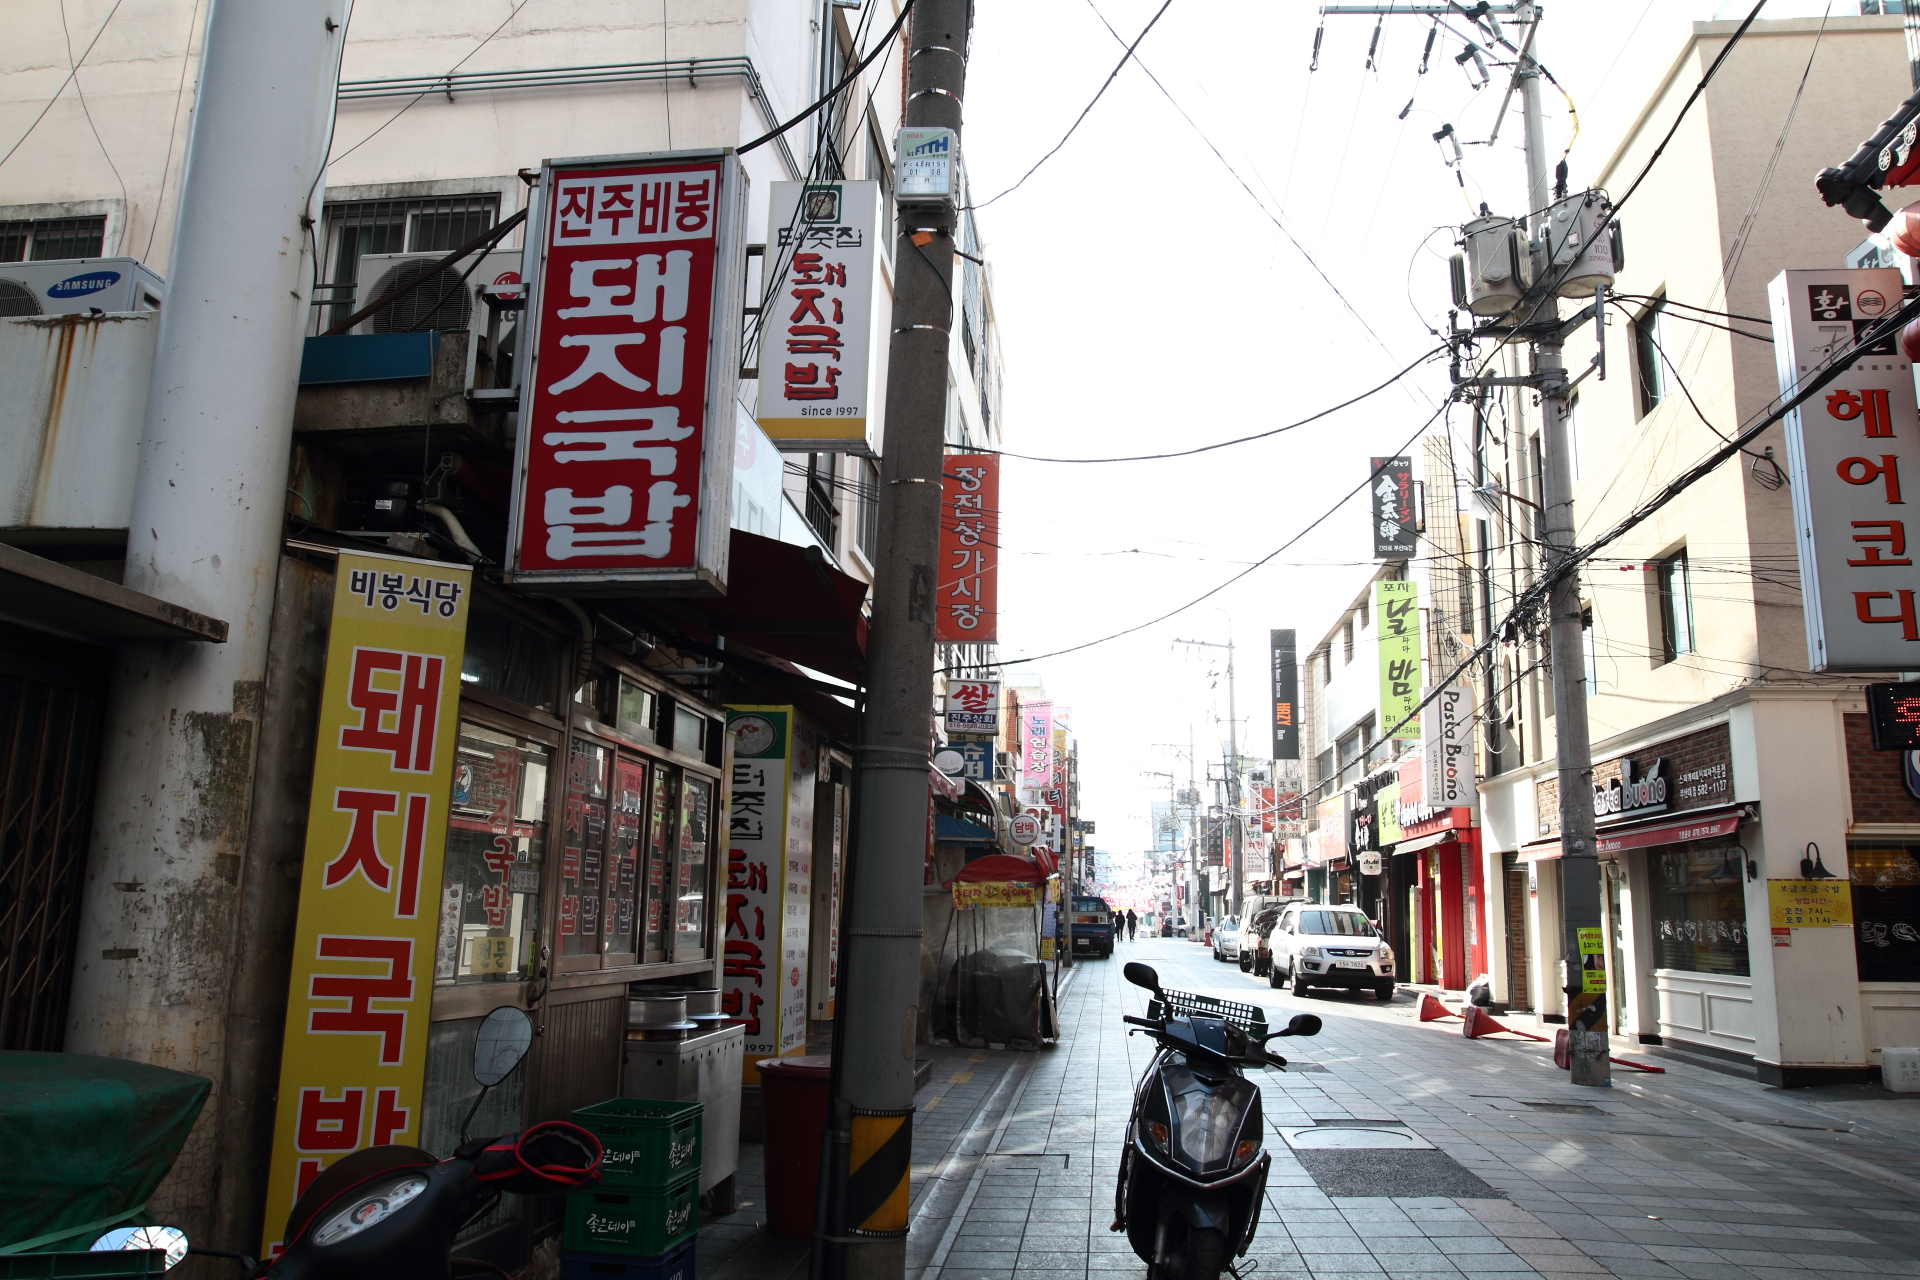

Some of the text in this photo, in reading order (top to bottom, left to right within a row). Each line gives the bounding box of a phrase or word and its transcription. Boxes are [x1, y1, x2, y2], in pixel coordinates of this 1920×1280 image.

[915, 136, 949, 156] FTTH
[559, 176, 711, 247] 진주비봉
[56, 278, 112, 291] SAMSUNG
[1813, 289, 1850, 320] 황
[783, 251, 848, 401] 돼지국밥
[542, 248, 697, 562] 돼지국밥
[801, 405, 859, 416] since 1997
[1396, 471, 1411, 524] サラリーマン
[1825, 388, 1919, 642] 헤어코디
[950, 464, 988, 631] 장전상가시장
[350, 569, 463, 619] 비봉식당
[1383, 582, 1410, 592] 포차
[951, 683, 995, 714] 쌀
[1276, 702, 1291, 726] HAZY
[950, 713, 994, 724] 진주상회
[1385, 715, 1396, 723] B1
[1027, 715, 1049, 774] 노래연습장
[1444, 690, 1463, 801] Pasta Buono
[728, 764, 766, 841] 터줏집
[1622, 775, 1667, 810] Buono
[1697, 779, 1728, 797] 582-1127
[481, 746, 521, 931] 돼지국밥
[1014, 822, 1035, 834] 담배
[560, 754, 588, 936] 선지국밥
[618, 773, 642, 936] 짬뽕국밥
[648, 782, 668, 934] 순대국밥
[1779, 884, 1841, 895] 보글보글 국밥
[1785, 907, 1803, 915] 오전
[1786, 916, 1804, 924] 오후
[477, 939, 510, 970] 전문
[722, 848, 769, 1037] 돼지국밥
[744, 1042, 774, 1054] 1997
[600, 1148, 635, 1164] 은데이
[669, 1137, 694, 1169] 좋은데이
[586, 1213, 631, 1234] 좋은데이
